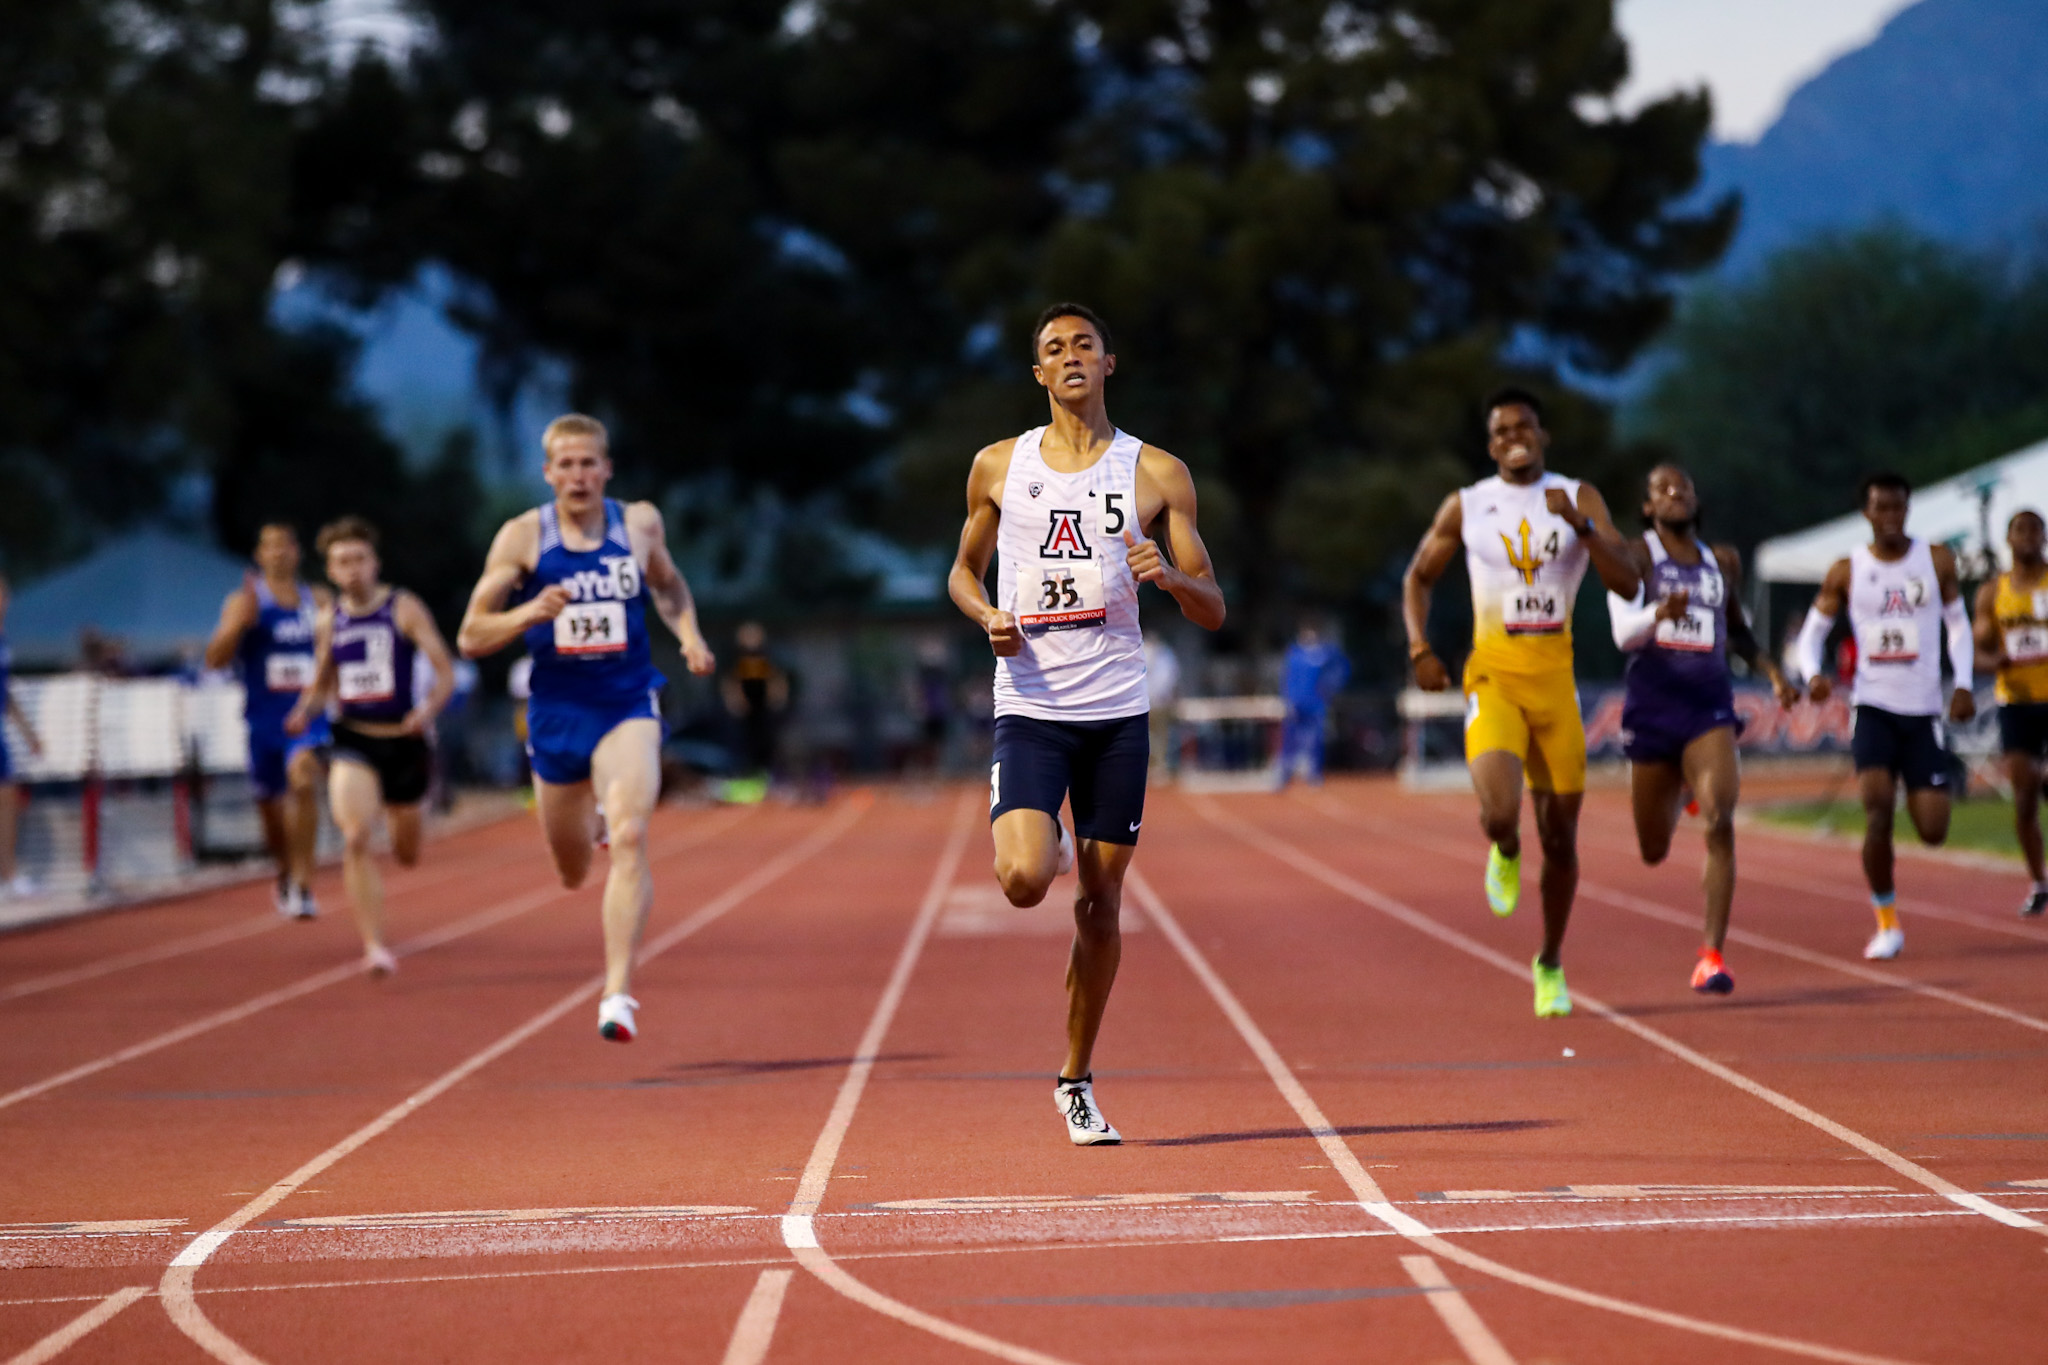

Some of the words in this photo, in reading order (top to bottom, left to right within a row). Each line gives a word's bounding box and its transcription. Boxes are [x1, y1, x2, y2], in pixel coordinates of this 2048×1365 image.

[1104, 493, 1126, 535] 5
[1039, 509, 1092, 560] A
[1543, 530, 1559, 559] 4
[617, 561, 634, 594] 6
[1041, 577, 1078, 610] 35
[570, 616, 611, 641] 134
[1049, 614, 1069, 623] CLICK
[1068, 610, 1105, 622] SHOOTOUT
